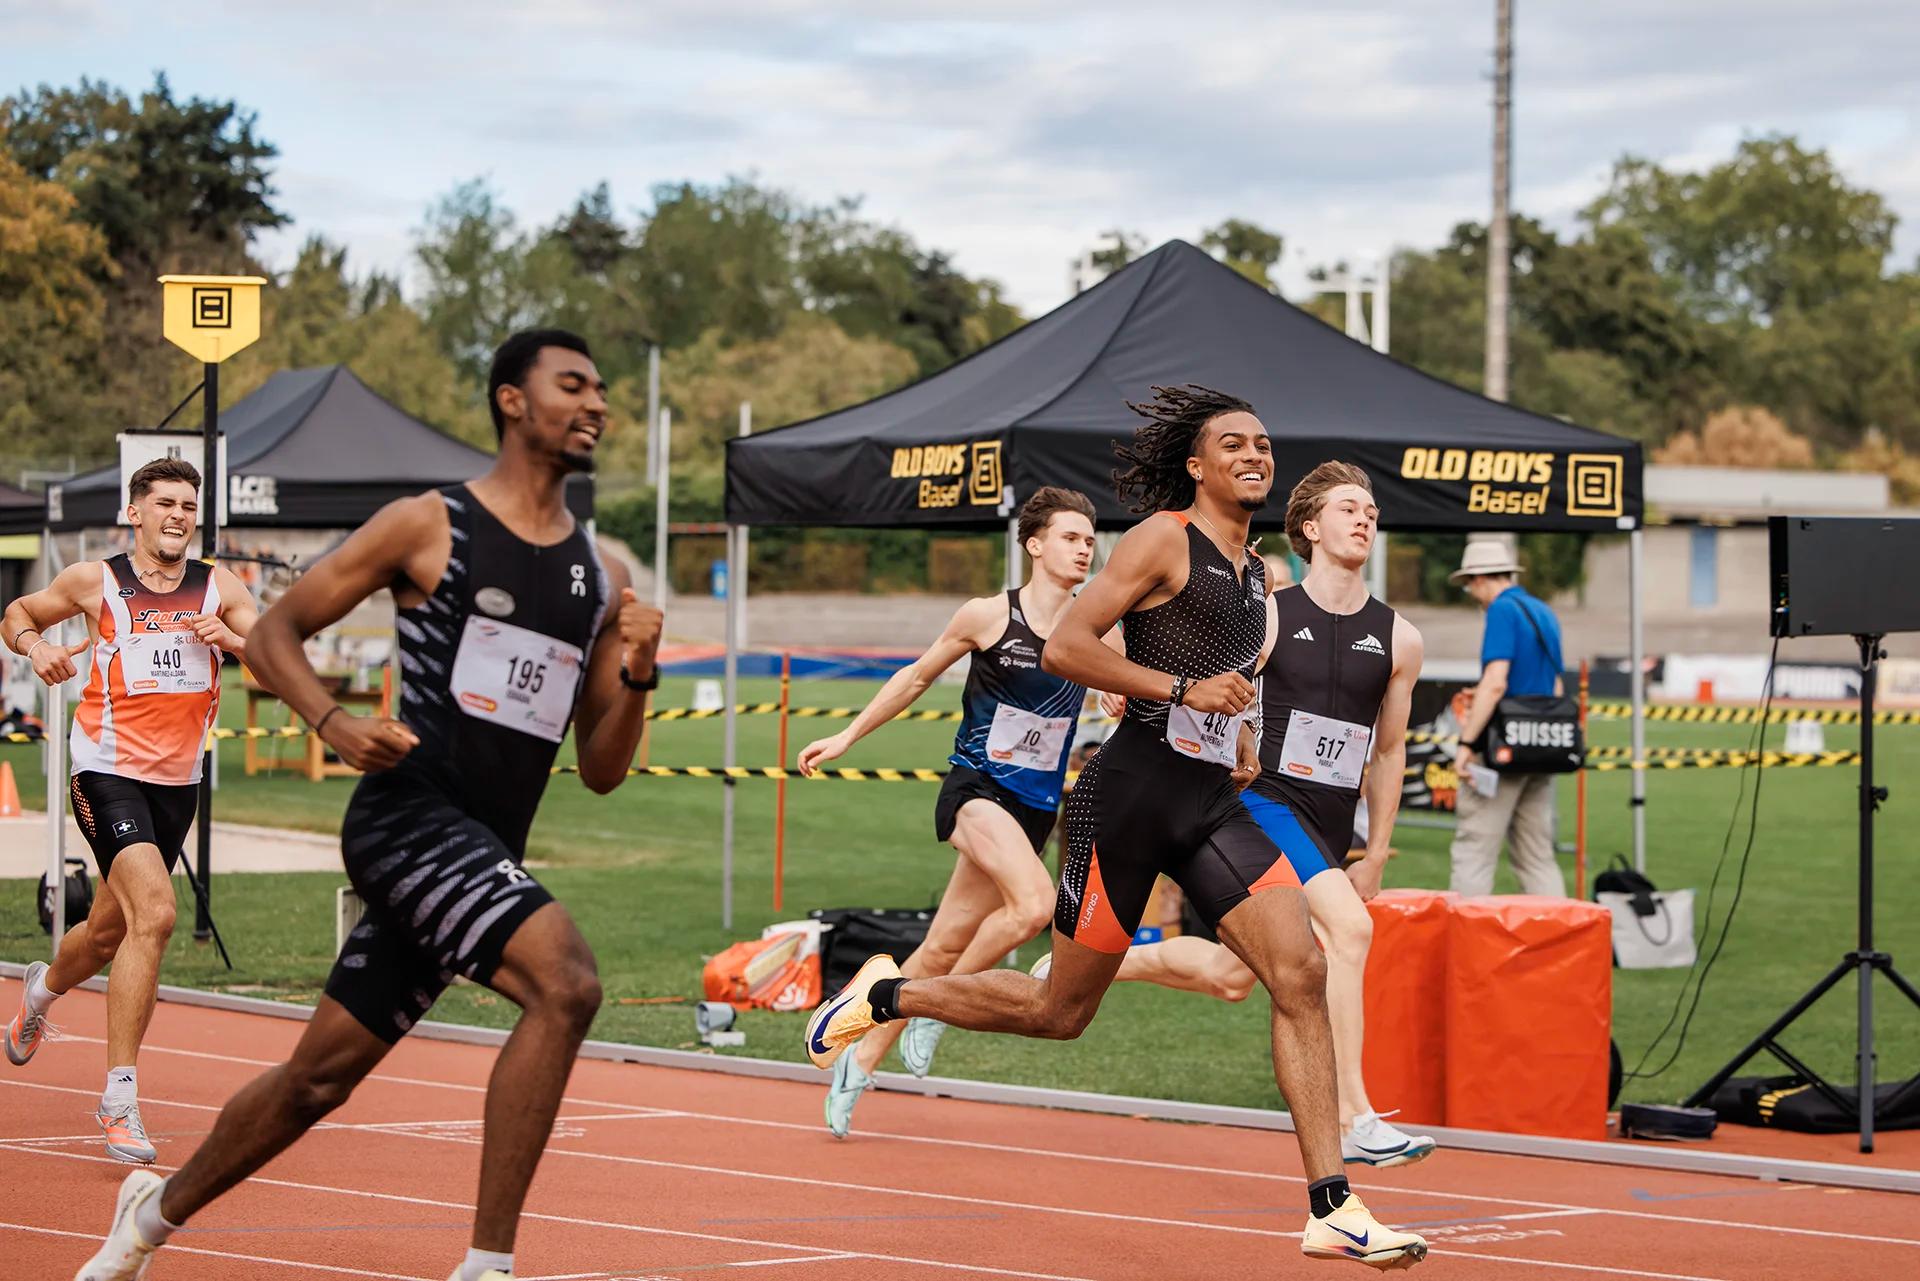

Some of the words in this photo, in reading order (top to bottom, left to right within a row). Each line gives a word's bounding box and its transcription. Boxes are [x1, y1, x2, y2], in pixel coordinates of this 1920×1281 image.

[891, 448, 923, 478] OLD
[921, 444, 968, 477] BOYS
[1400, 447, 1467, 481] OLD
[1468, 450, 1555, 484] BOYS
[918, 477, 964, 508] Basel
[1467, 483, 1551, 515] Basel
[153, 649, 181, 668] 440
[507, 656, 546, 693] 195
[1023, 728, 1040, 746] 10
[1203, 712, 1231, 738] 482
[1504, 720, 1576, 748] SUISSE
[1315, 735, 1346, 760] 517
[1084, 893, 1099, 923] CRAFT
